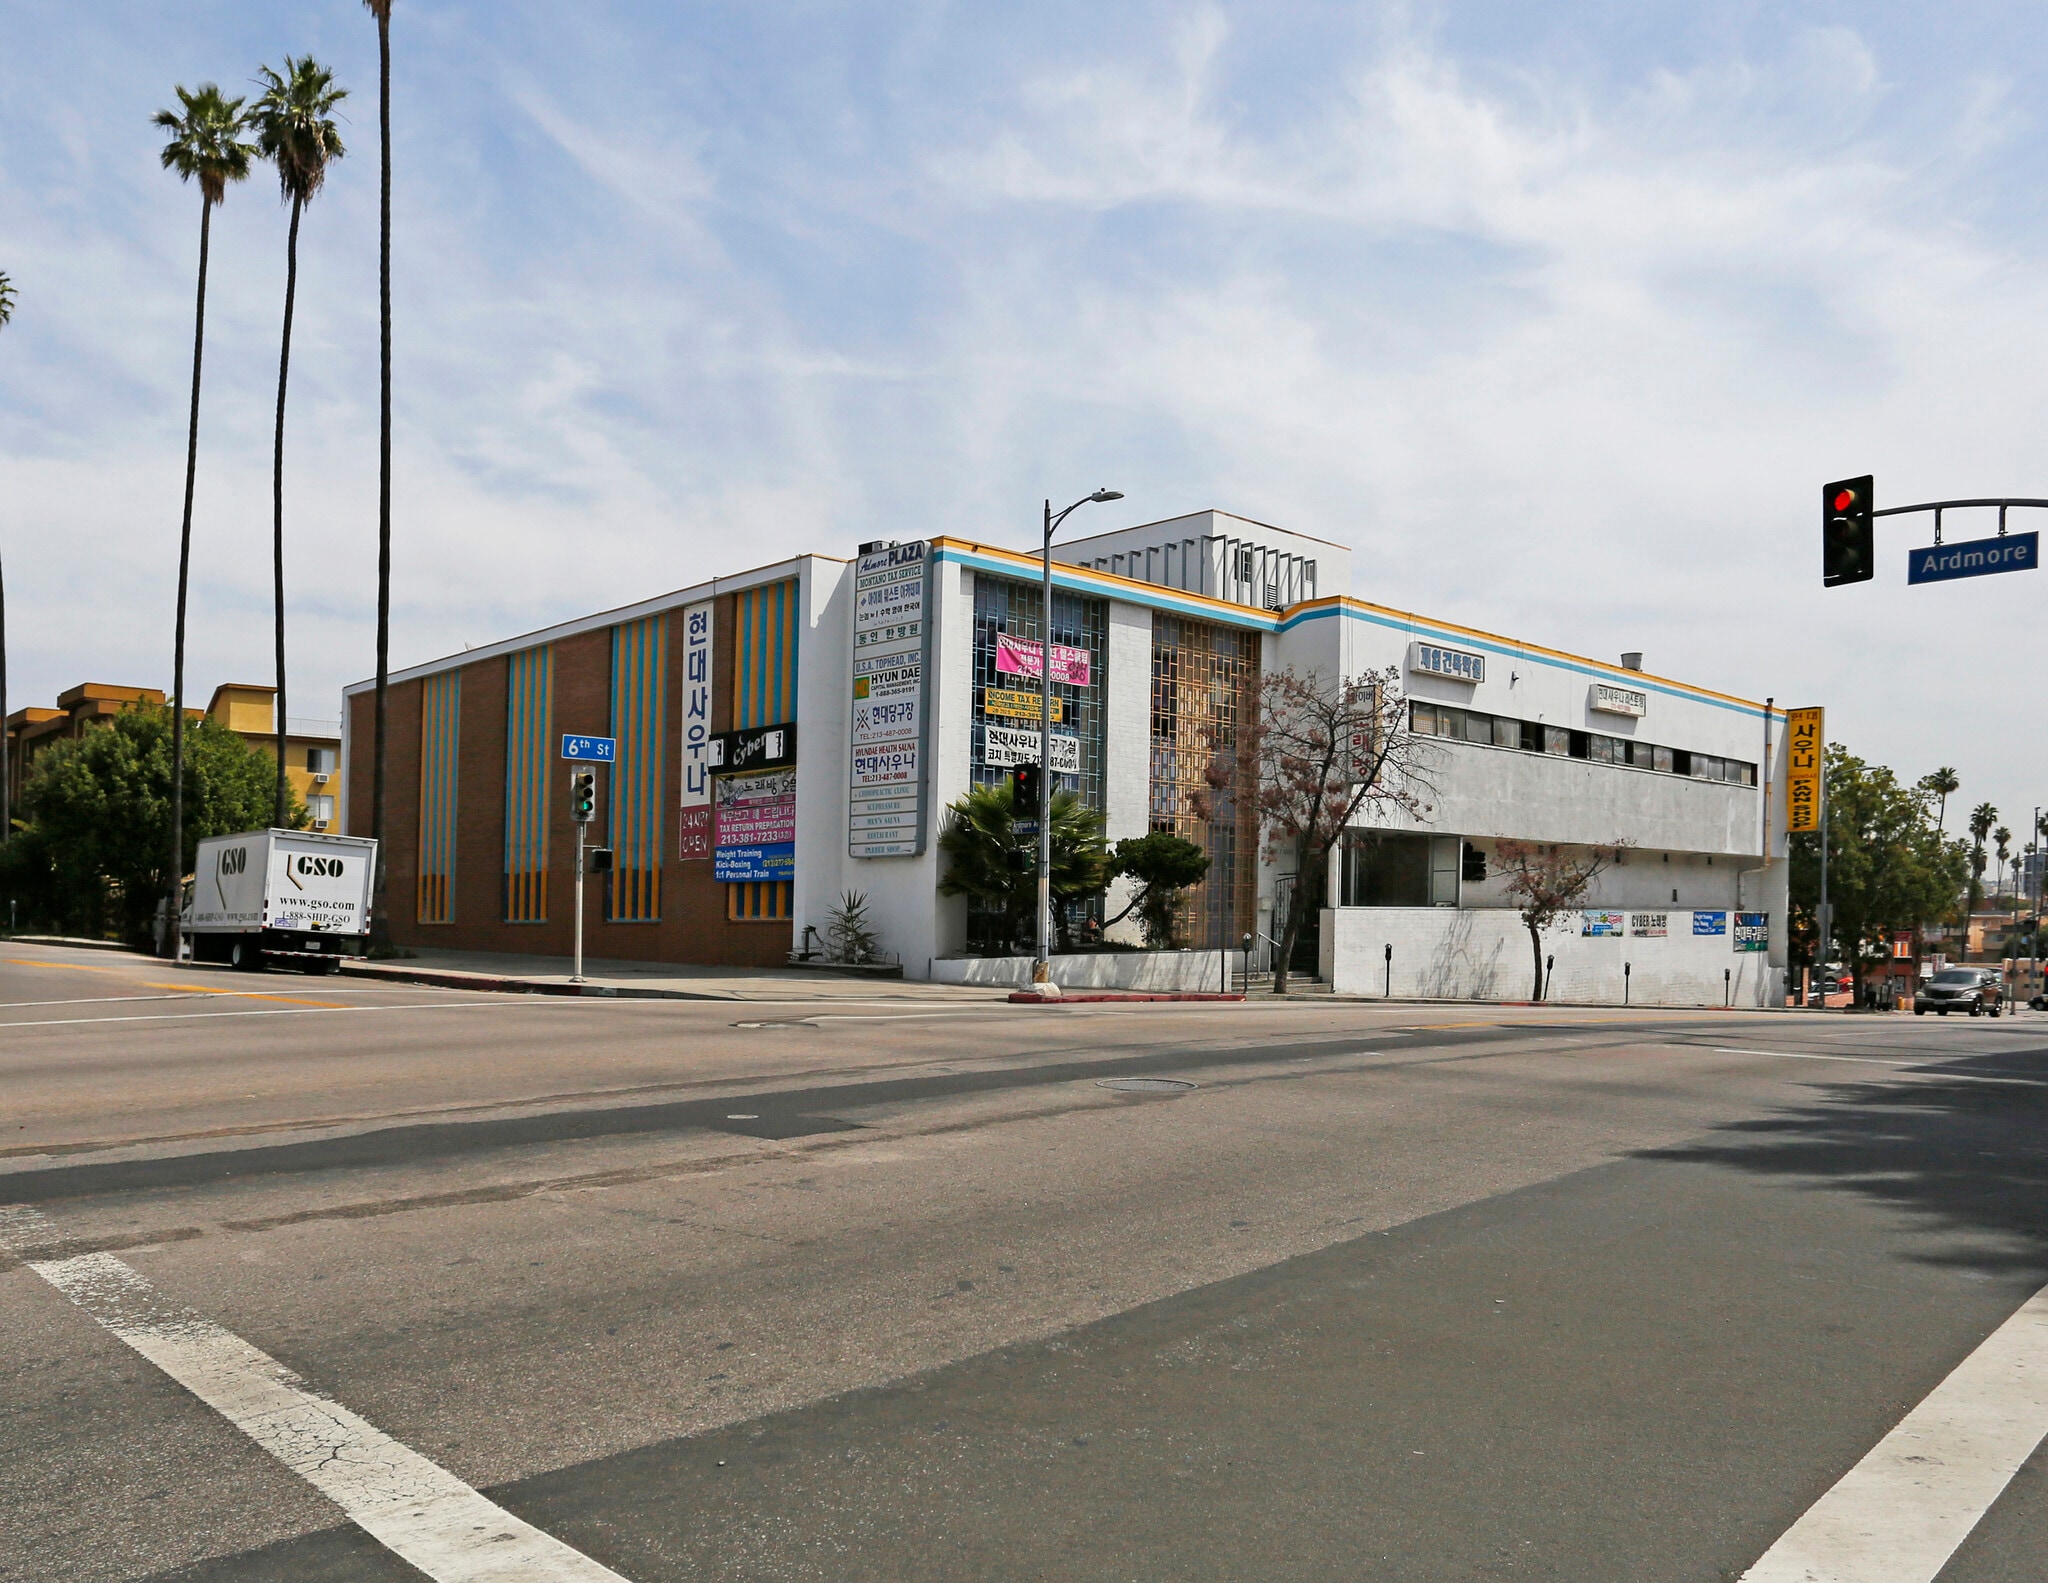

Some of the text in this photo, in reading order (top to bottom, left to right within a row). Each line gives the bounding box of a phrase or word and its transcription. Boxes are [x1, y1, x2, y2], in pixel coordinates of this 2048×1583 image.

[888, 544, 922, 567] PLAZA
[1922, 545, 2027, 573] Ardmore
[860, 565, 921, 589] MONTANO TAX SERVICE
[856, 652, 921, 673] U.S.A. TOPHEAD, INC.
[871, 667, 920, 685] HYUN DAE
[1017, 665, 1069, 681] 213-48-0008
[886, 680, 912, 689] MANAGEMENT,
[687, 611, 708, 796] 현대사우나
[1017, 695, 1031, 705] TAX
[1032, 696, 1059, 708] RERN
[872, 701, 915, 725] 현대당구장
[568, 739, 610, 756] 6th St
[989, 729, 1038, 750] 현대사우나
[1793, 723, 1816, 769] 사우나
[732, 732, 767, 765] Cyber
[855, 742, 916, 757] HYUNDAE HEALTH SAUNA
[855, 752, 916, 775] 현대사우나
[743, 777, 777, 795] 노래방
[893, 786, 910, 795] CLINIC
[763, 806, 795, 819] 드립니다
[720, 825, 730, 833] TAX
[731, 823, 754, 832] RETURN
[867, 831, 898, 839] RESTAURANT
[683, 835, 707, 853] OPEN
[721, 831, 778, 844] 213-381-7233
[222, 847, 246, 875] GSO
[716, 851, 736, 860] Weight
[737, 849, 762, 859] Training
[297, 856, 344, 878] GSO
[725, 870, 752, 879] Personal
[753, 868, 770, 878] Train
[280, 897, 355, 911] www.gso.com
[282, 911, 350, 924] 1-888-SHIP-GSO
[1632, 915, 1649, 927] CYBER
